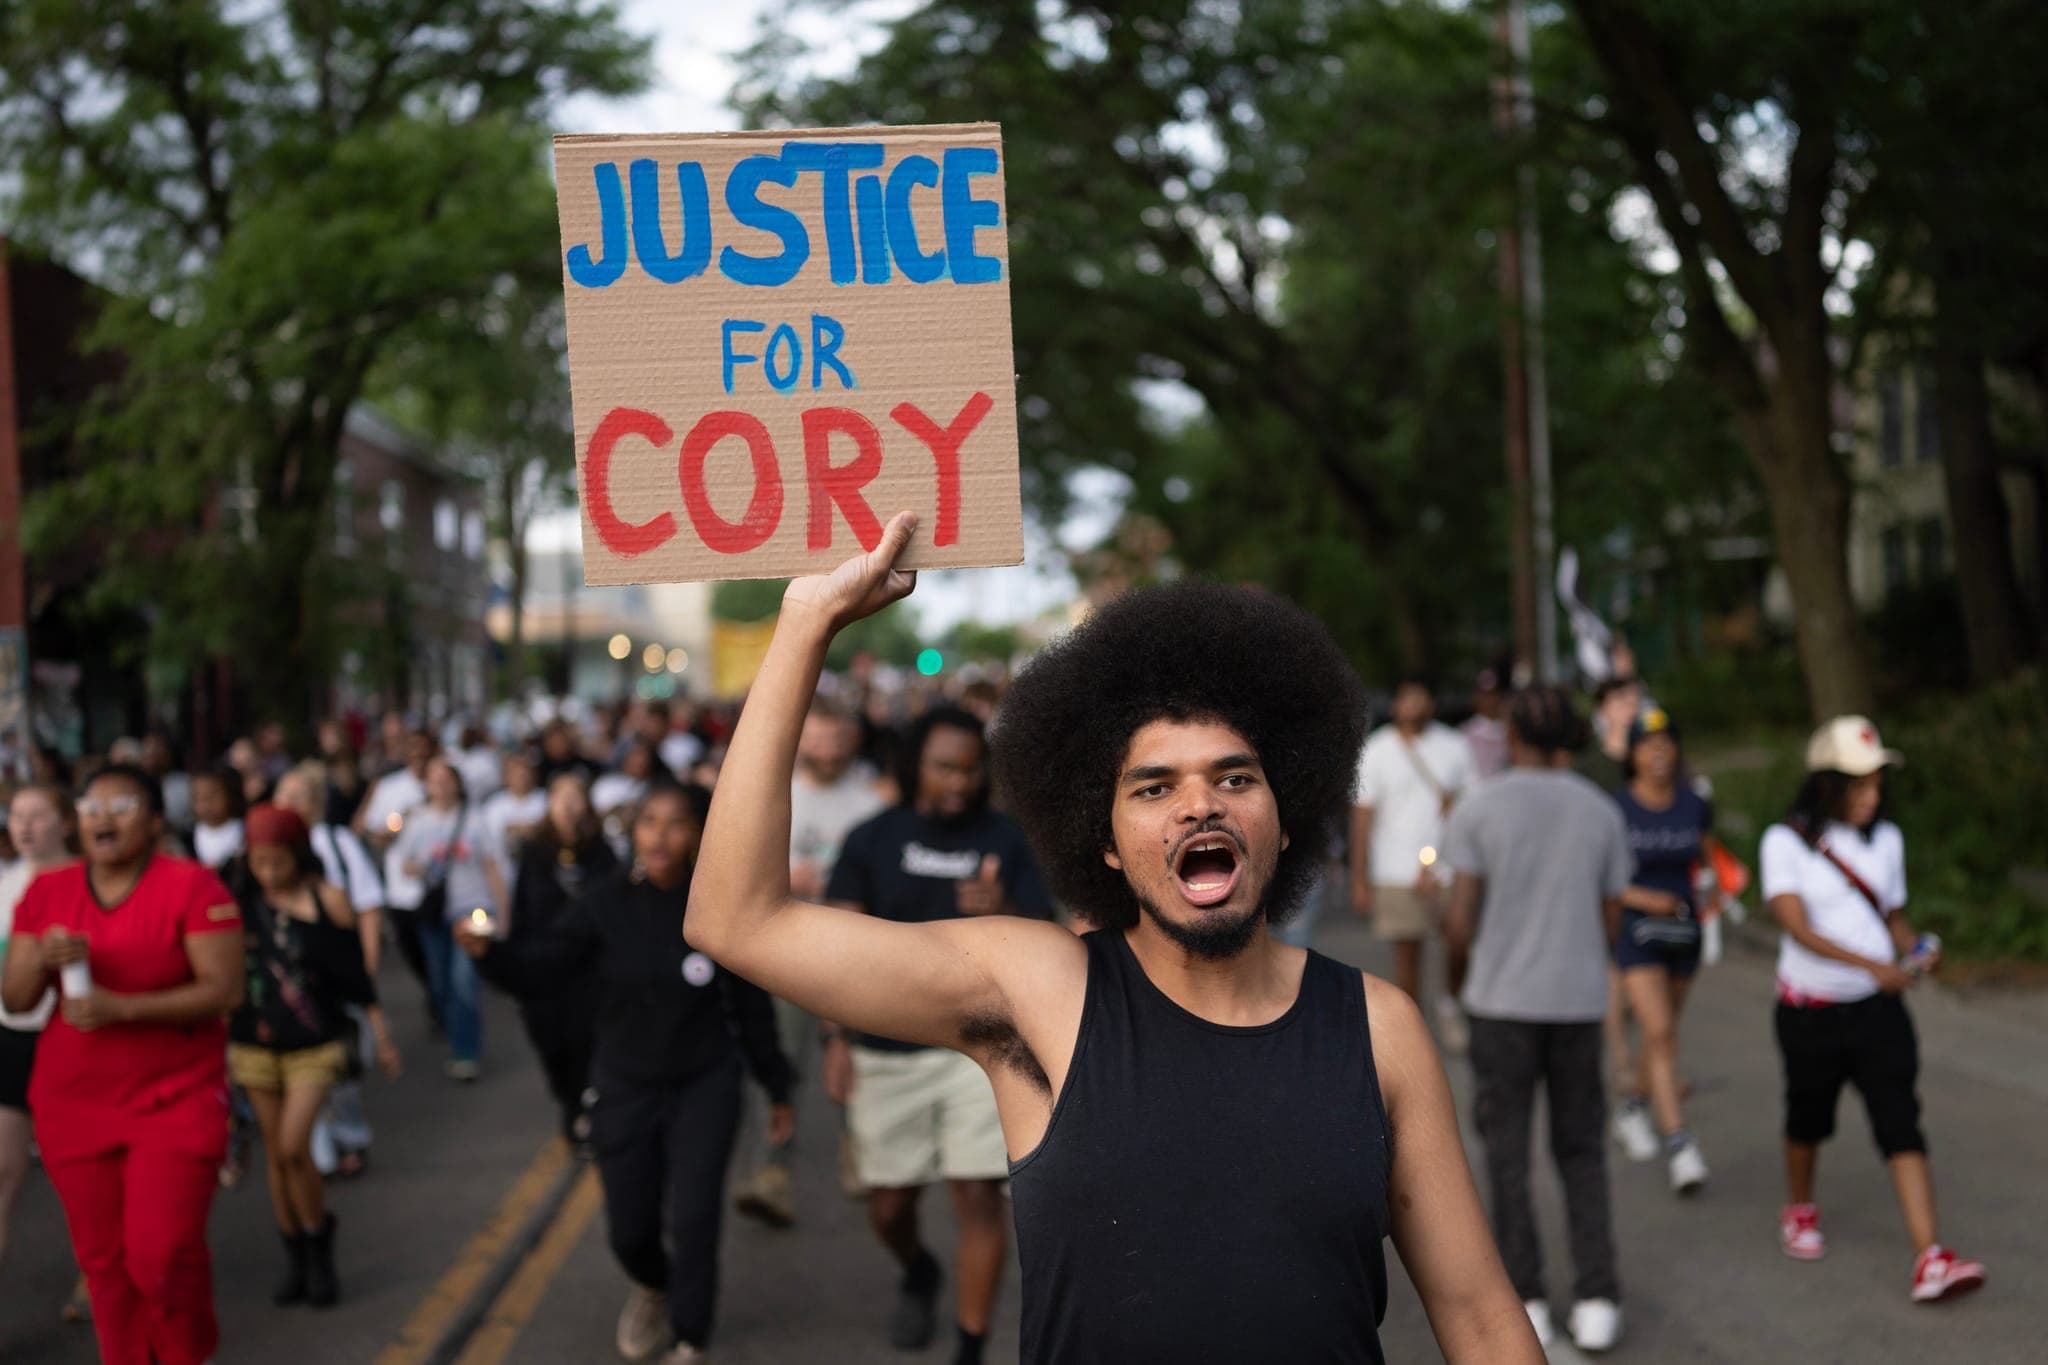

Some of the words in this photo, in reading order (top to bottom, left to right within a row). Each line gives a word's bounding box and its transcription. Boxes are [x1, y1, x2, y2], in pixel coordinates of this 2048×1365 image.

[567, 142, 1003, 287] JUSTICE
[721, 313, 857, 395] FOR
[582, 391, 994, 558] CORY
